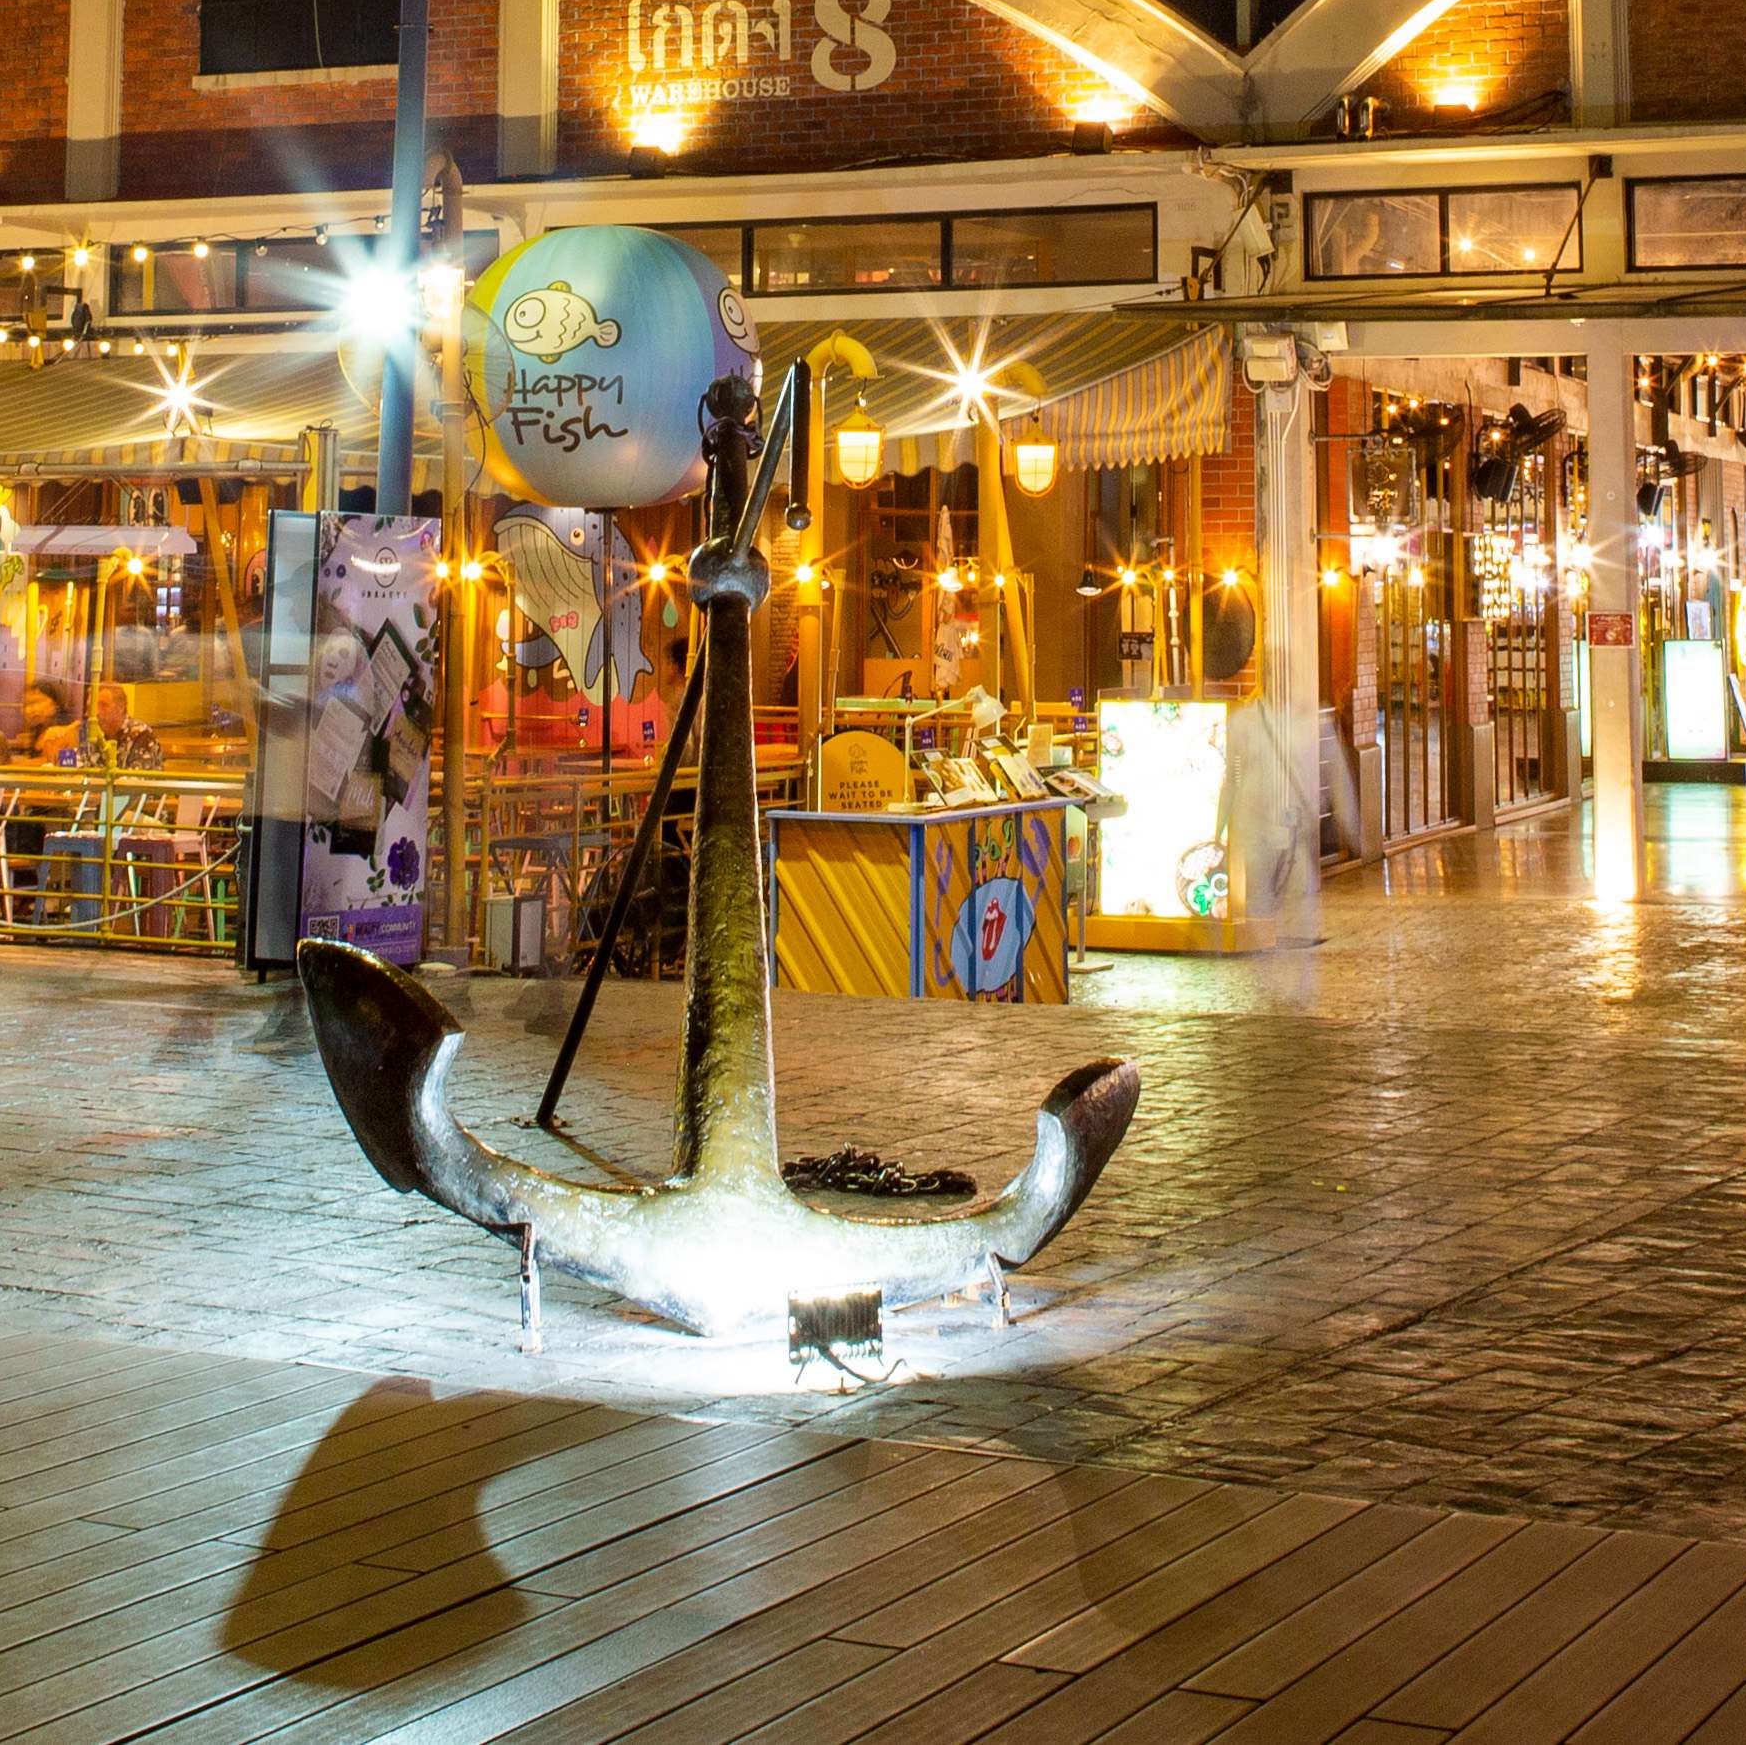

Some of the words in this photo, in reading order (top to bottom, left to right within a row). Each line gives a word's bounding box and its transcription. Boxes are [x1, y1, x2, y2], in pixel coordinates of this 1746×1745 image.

[629, 76, 791, 107] WAREHOUSE
[505, 368, 624, 406] Happy
[506, 405, 629, 452] Fish
[828, 790, 857, 800] WAIT
[862, 790, 875, 799] TO
[880, 789, 892, 798] BE
[839, 780, 880, 790] PLEASE
[841, 800, 883, 810] SEATED
